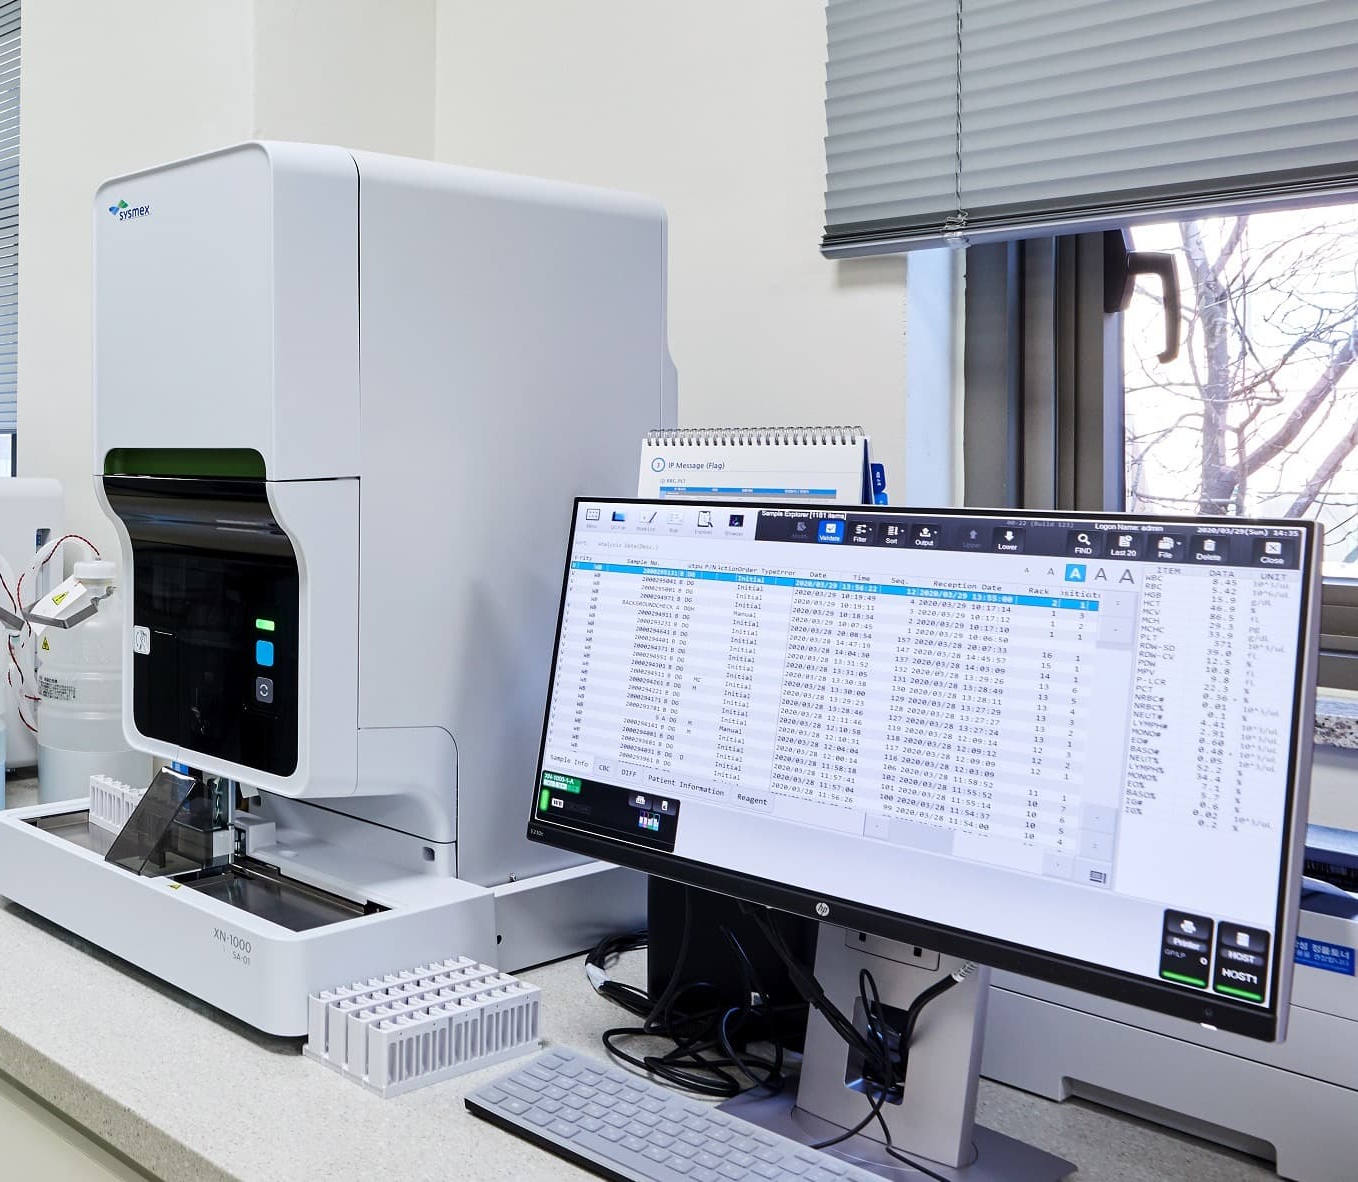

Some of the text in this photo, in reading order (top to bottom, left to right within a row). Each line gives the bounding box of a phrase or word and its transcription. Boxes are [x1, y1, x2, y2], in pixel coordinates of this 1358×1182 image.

[119, 205, 150, 221] sysmex
[676, 461, 705, 471] Message
[706, 461, 725, 471] (Flag)
[1069, 568, 1081, 578] A
[1094, 567, 1108, 580] A
[1119, 569, 1136, 584] A
[1208, 570, 1235, 578] DATA
[933, 581, 976, 590] Reception
[726, 673, 752, 681] Initial
[717, 744, 744, 753] Initial
[621, 768, 637, 777] DIFF
[648, 774, 724, 796] Patient Information
[737, 793, 768, 807] Reagent
[816, 902, 829, 917] hp
[213, 927, 252, 954] XN-1000
[232, 951, 250, 966] SA-01
[1228, 951, 1255, 963] HOST
[1222, 967, 1258, 985] HOST1
